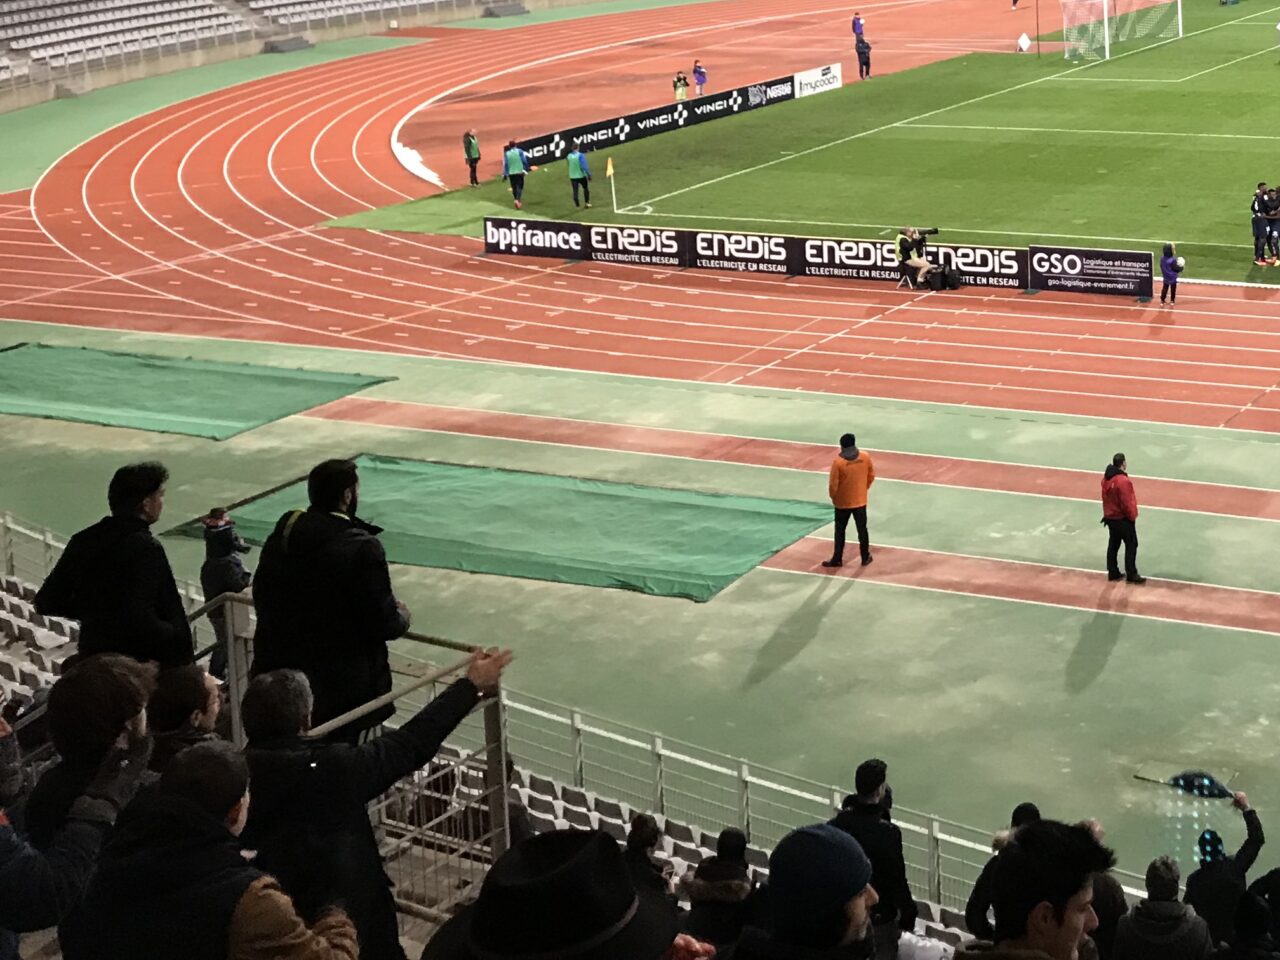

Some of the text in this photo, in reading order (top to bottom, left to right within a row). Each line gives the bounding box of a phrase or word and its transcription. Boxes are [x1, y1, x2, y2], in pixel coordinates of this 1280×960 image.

[694, 100, 728, 115] VINCI
[637, 113, 672, 130] VINCI
[573, 128, 612, 144] VINCI
[486, 221, 582, 253] bpifrance
[641, 255, 651, 263] EN
[652, 256, 679, 265] RESEAU
[748, 262, 757, 270] EN
[759, 264, 787, 273] RESEAU
[1032, 252, 1082, 275] GSO
[860, 270, 870, 278] EN
[871, 271, 900, 280] RESEAU
[976, 276, 987, 285] EN
[989, 277, 1019, 287] RESEAU
